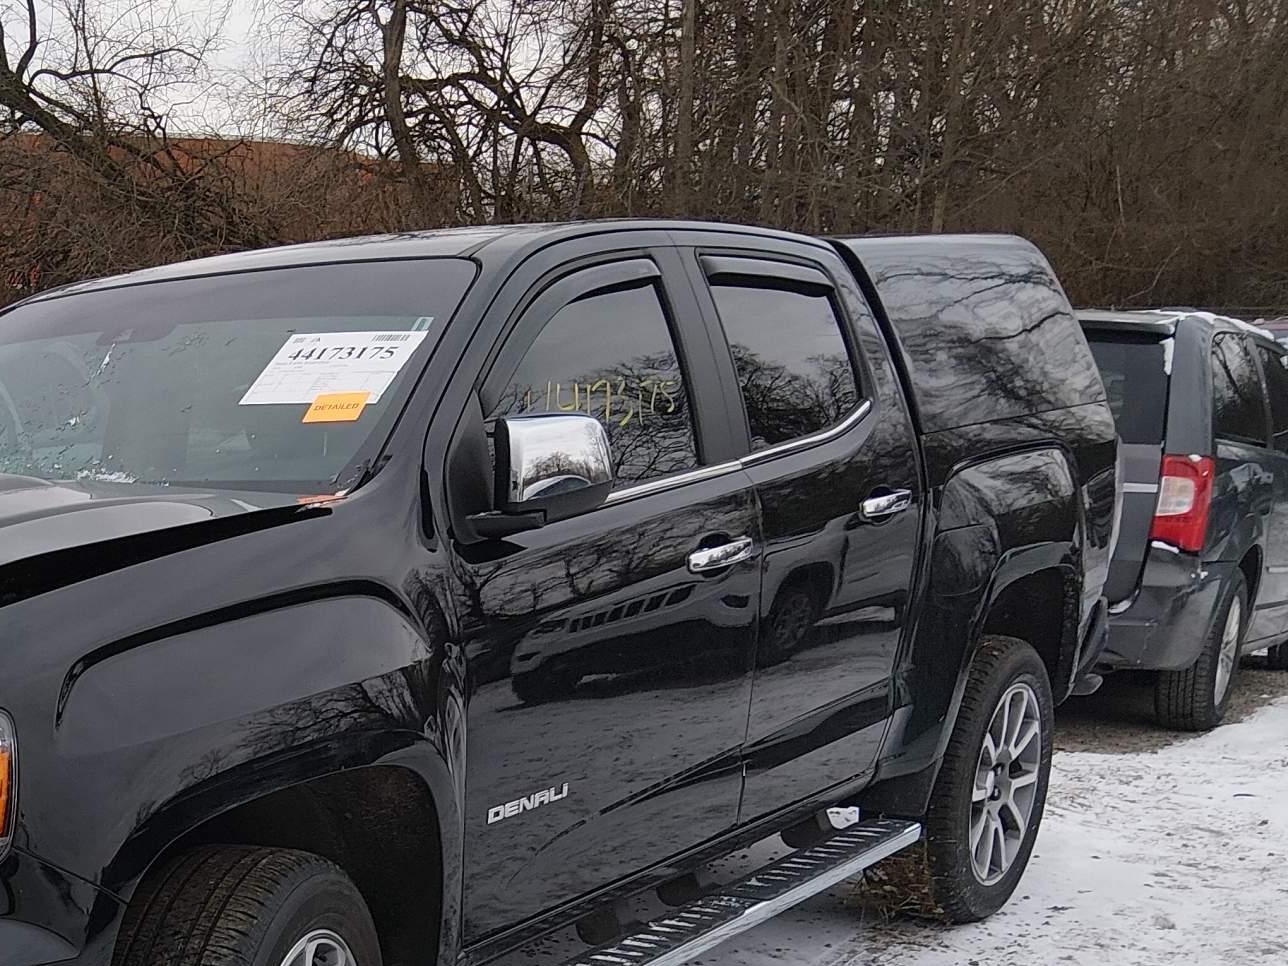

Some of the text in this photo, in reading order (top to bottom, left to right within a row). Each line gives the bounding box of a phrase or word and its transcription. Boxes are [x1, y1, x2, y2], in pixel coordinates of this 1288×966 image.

[288, 346, 399, 361] 44173175
[313, 402, 360, 411] DETAILED
[487, 782, 569, 824] DENALI
